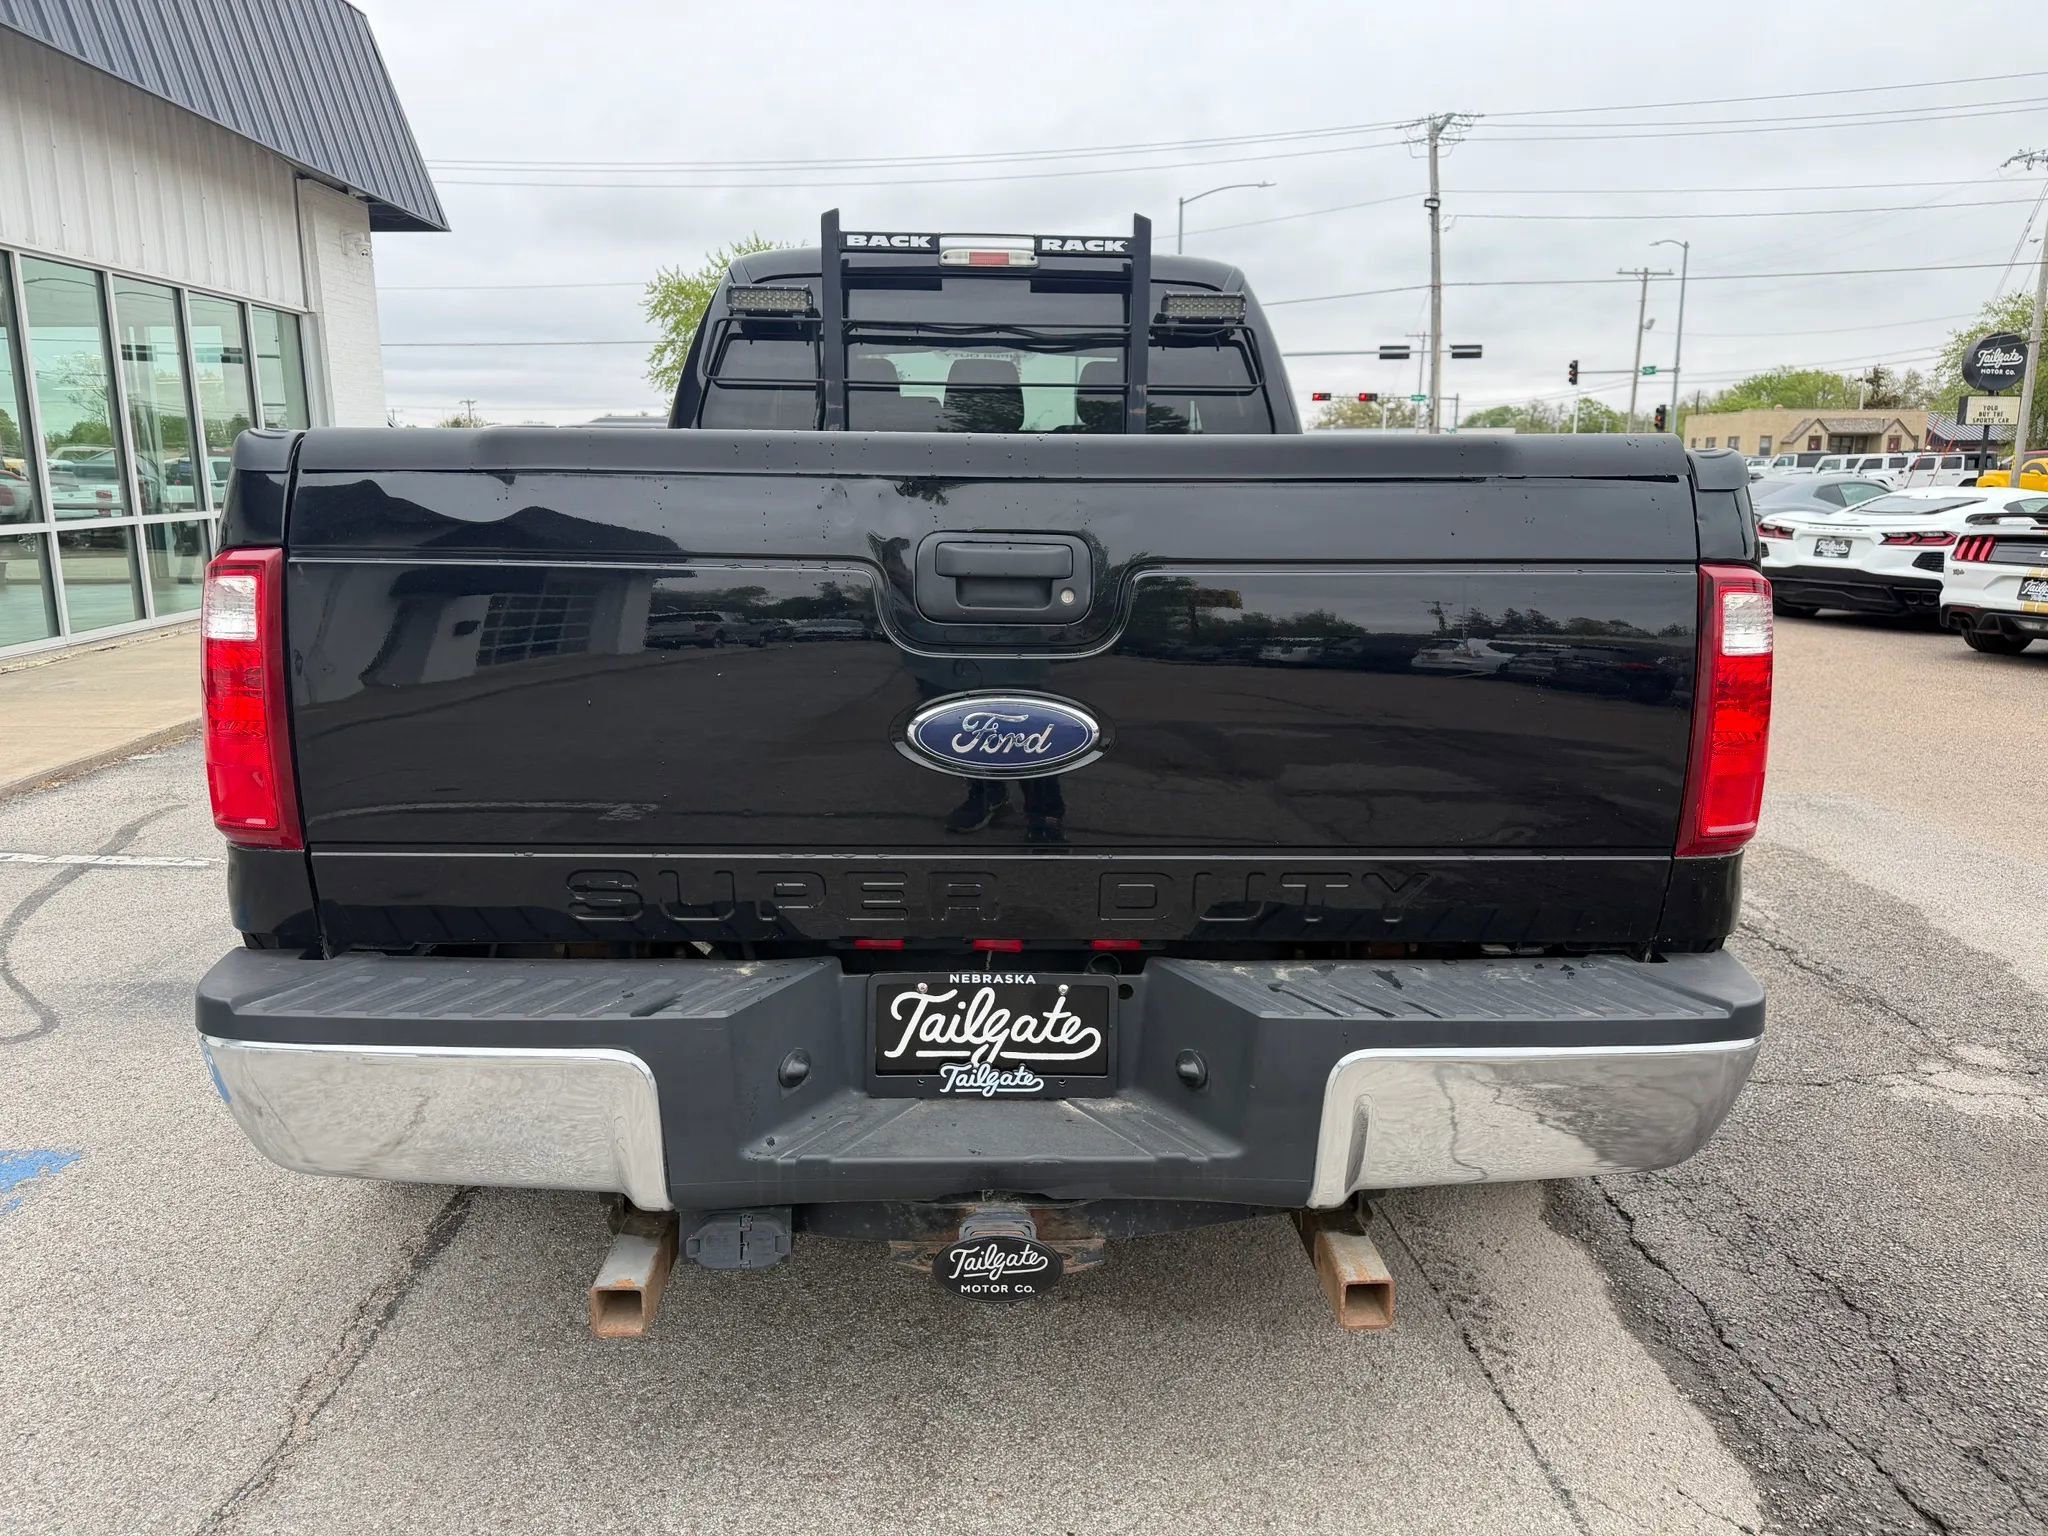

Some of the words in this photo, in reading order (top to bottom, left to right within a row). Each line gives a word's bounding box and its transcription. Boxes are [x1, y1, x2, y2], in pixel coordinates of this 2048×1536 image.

[846, 234, 931, 248] BACK
[1041, 238, 1125, 252] RACK
[1976, 347, 2024, 369] Tailgate
[951, 712, 1055, 754] Ford
[566, 869, 999, 922] SUPER
[1097, 871, 1436, 923] DUTY
[949, 973, 1037, 985] NEBRASKA
[884, 986, 1102, 1068] Tailgate
[939, 1061, 1045, 1098] Tailgate
[948, 1243, 1049, 1281] Tailgate
[960, 1284, 1009, 1293] MOTOR
